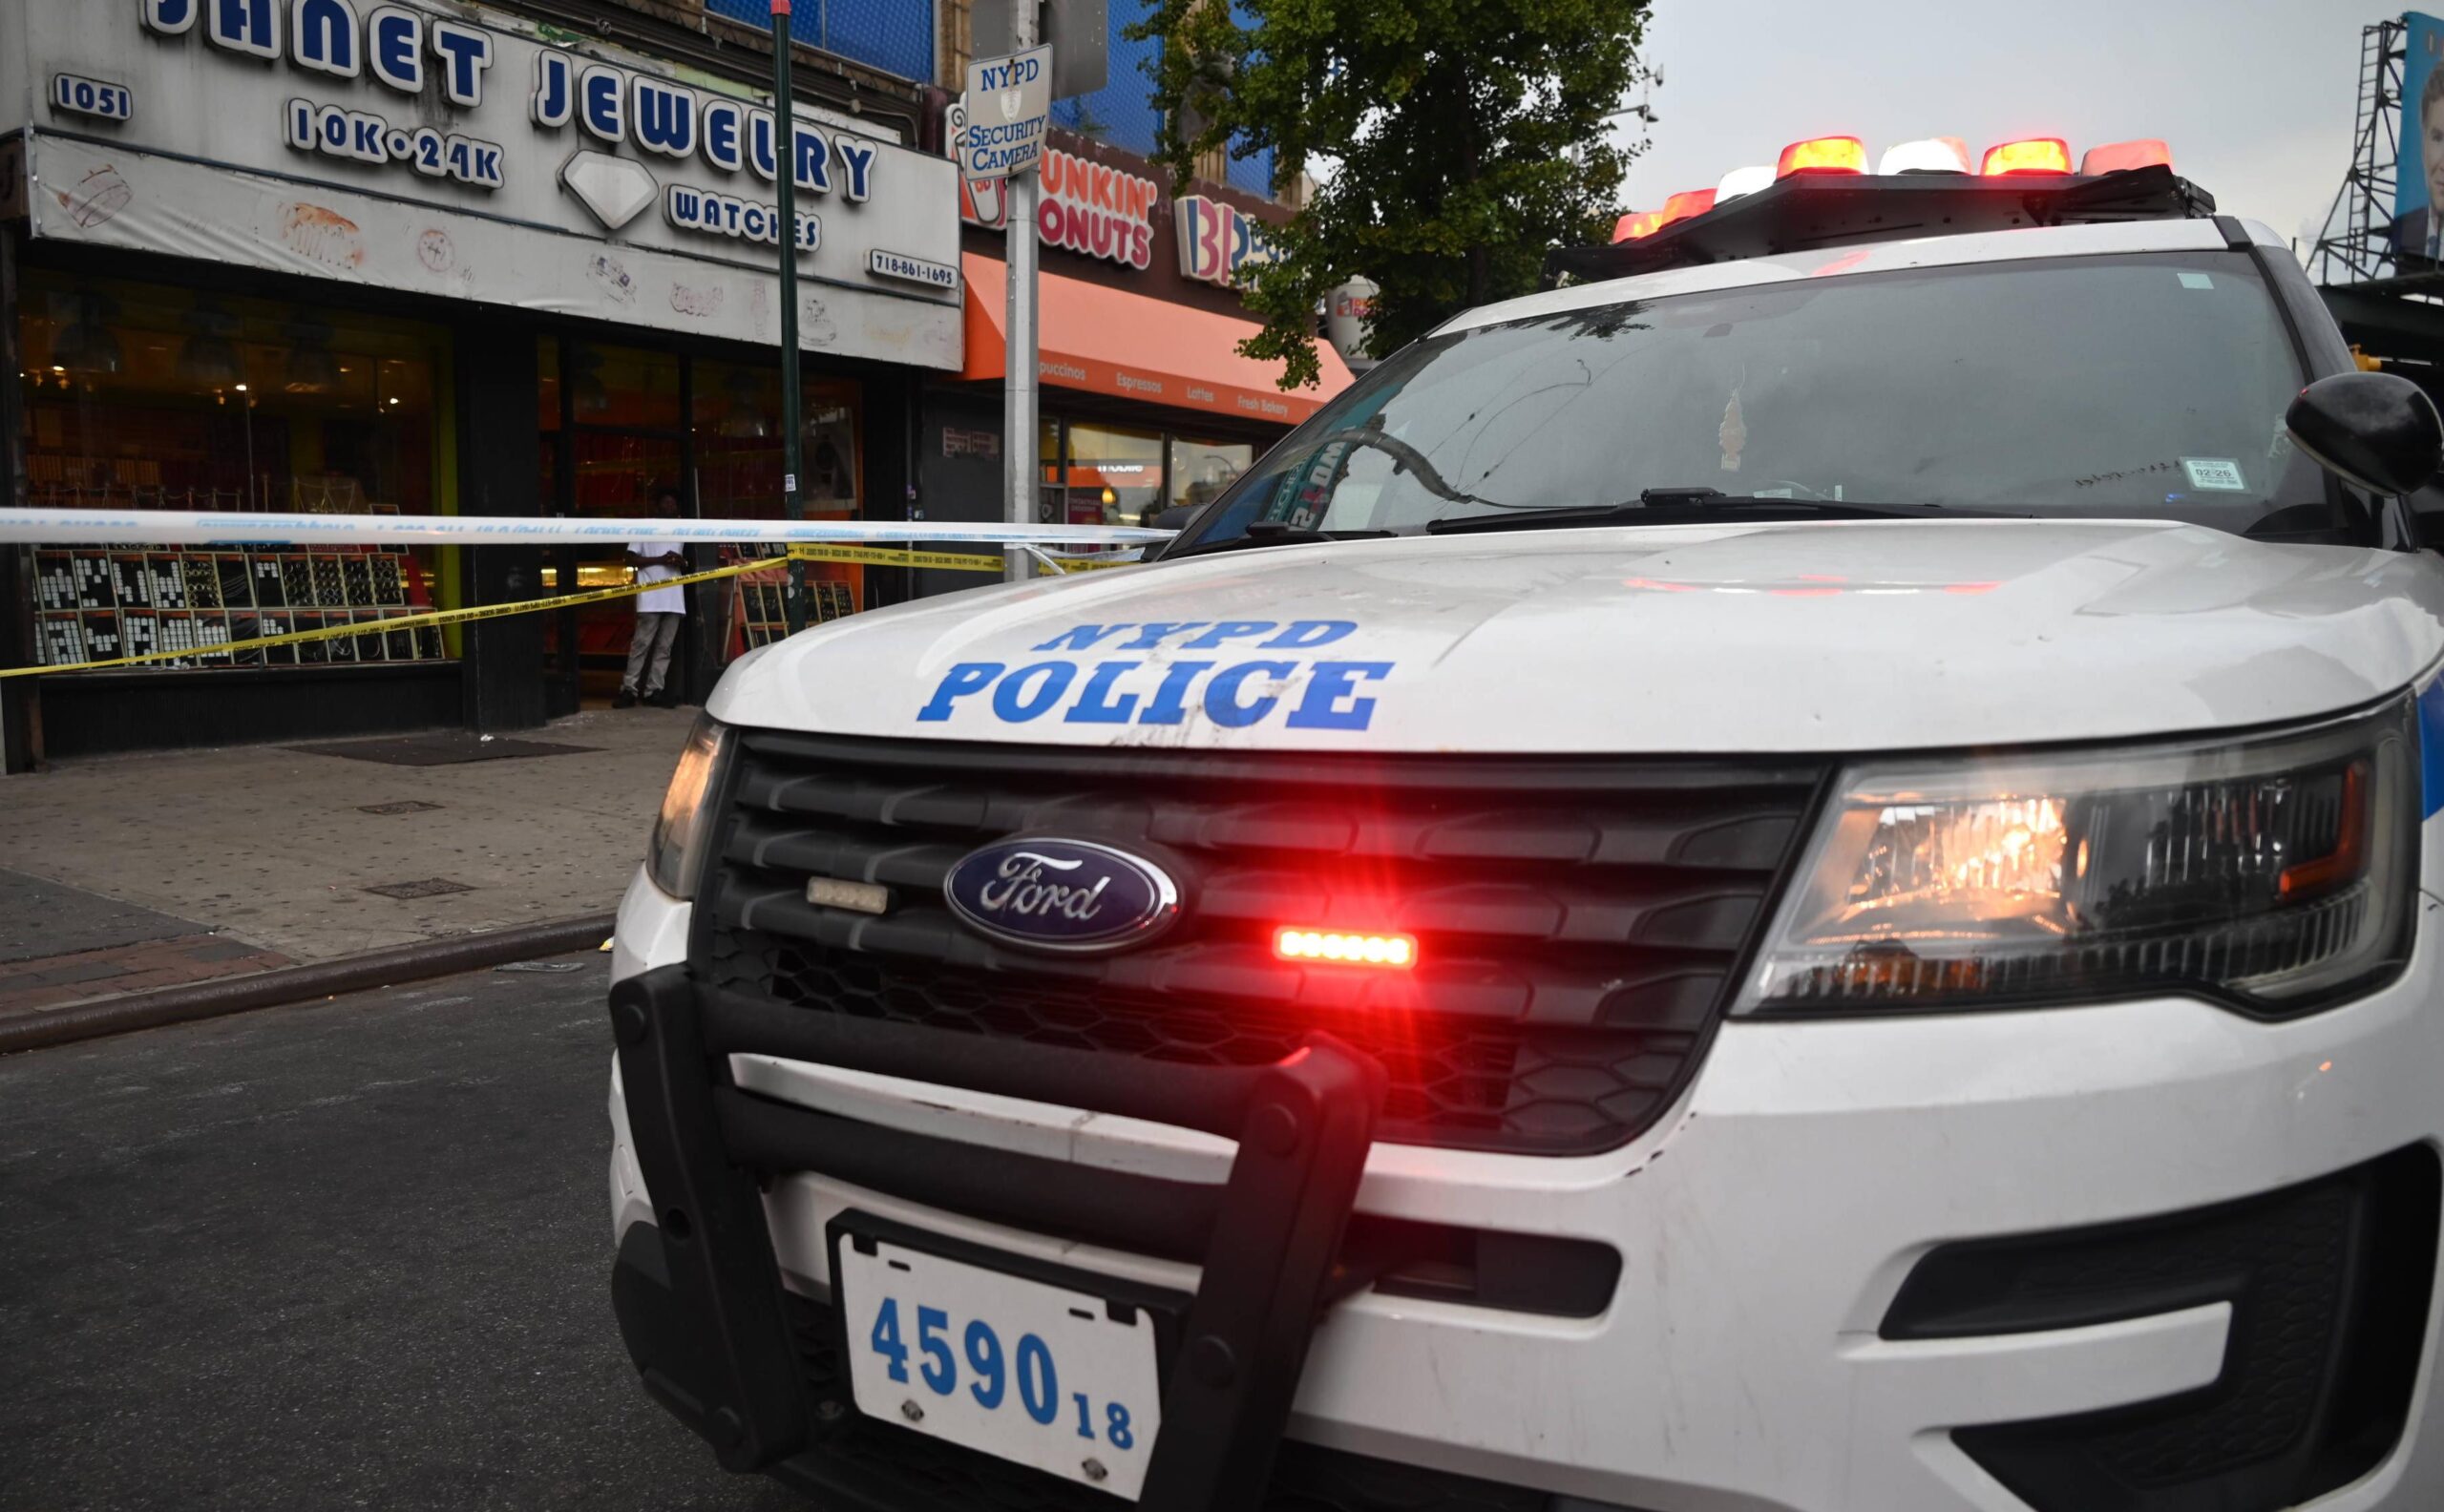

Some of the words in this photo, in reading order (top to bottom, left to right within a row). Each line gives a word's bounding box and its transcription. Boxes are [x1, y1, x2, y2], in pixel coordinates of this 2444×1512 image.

[980, 58, 1039, 92] NYPD
[61, 77, 127, 117] 1051
[968, 115, 1046, 149] SECURITY
[972, 140, 1038, 172] CAMERA
[1040, 149, 1156, 221] UNKIN'
[1038, 198, 1149, 267] ONUTS
[876, 254, 952, 284] 718-861-1695
[1039, 362, 1085, 381] puccinos
[1116, 371, 1162, 392] Espressos
[1031, 620, 1358, 651] NYPD
[916, 661, 1396, 731] POLICE
[980, 851, 1112, 922] Ford
[871, 1296, 1059, 1425] 4590
[1072, 1392, 1134, 1451] 18
